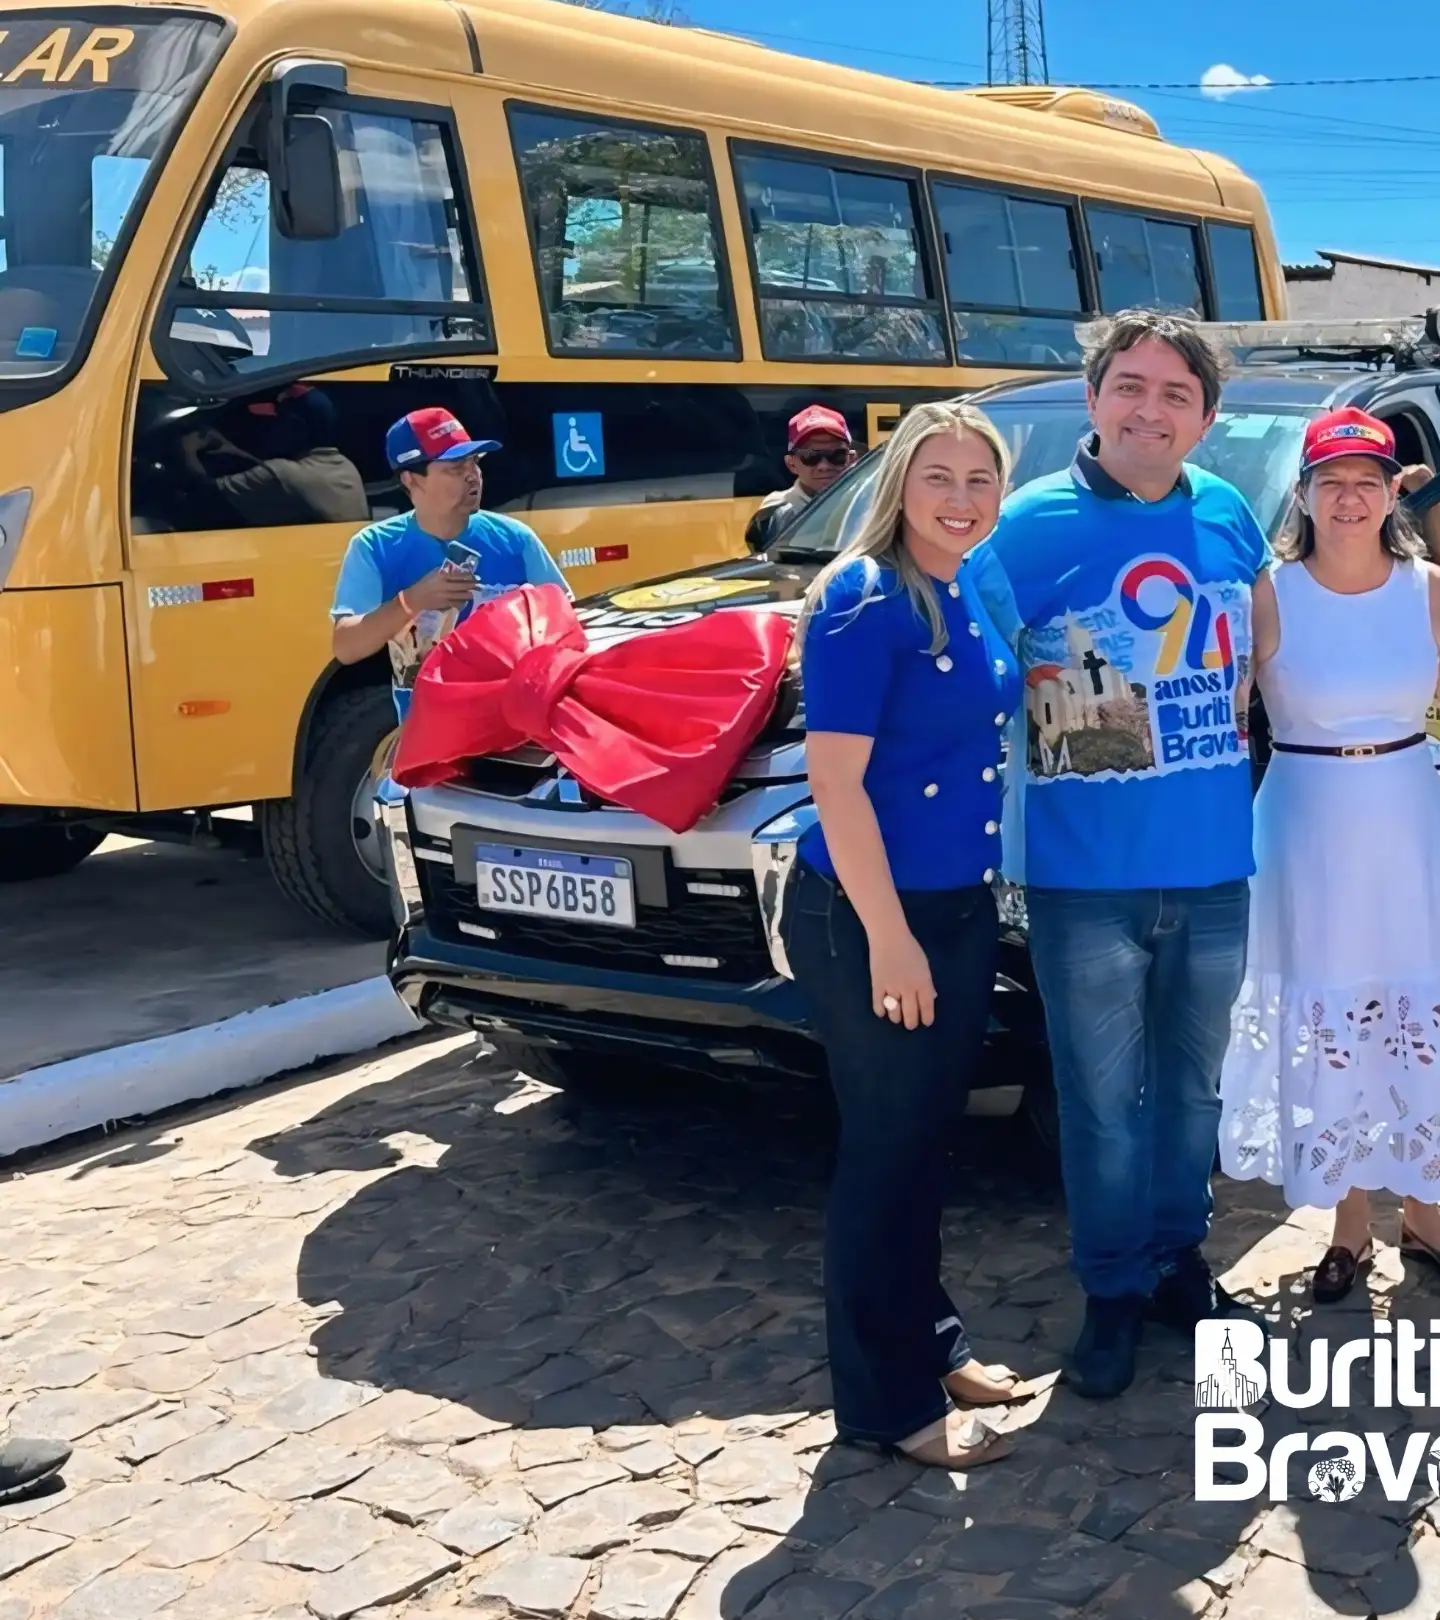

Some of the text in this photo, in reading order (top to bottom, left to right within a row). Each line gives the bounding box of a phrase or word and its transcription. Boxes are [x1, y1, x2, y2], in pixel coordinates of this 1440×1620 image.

[0, 27, 134, 82] AR
[395, 366, 490, 379] THUNDER
[1120, 560, 1235, 692] 94
[1155, 671, 1222, 701] anos
[1157, 695, 1232, 735] Buriti
[1161, 730, 1240, 764] Bravo
[491, 867, 616, 917] SSP6B58
